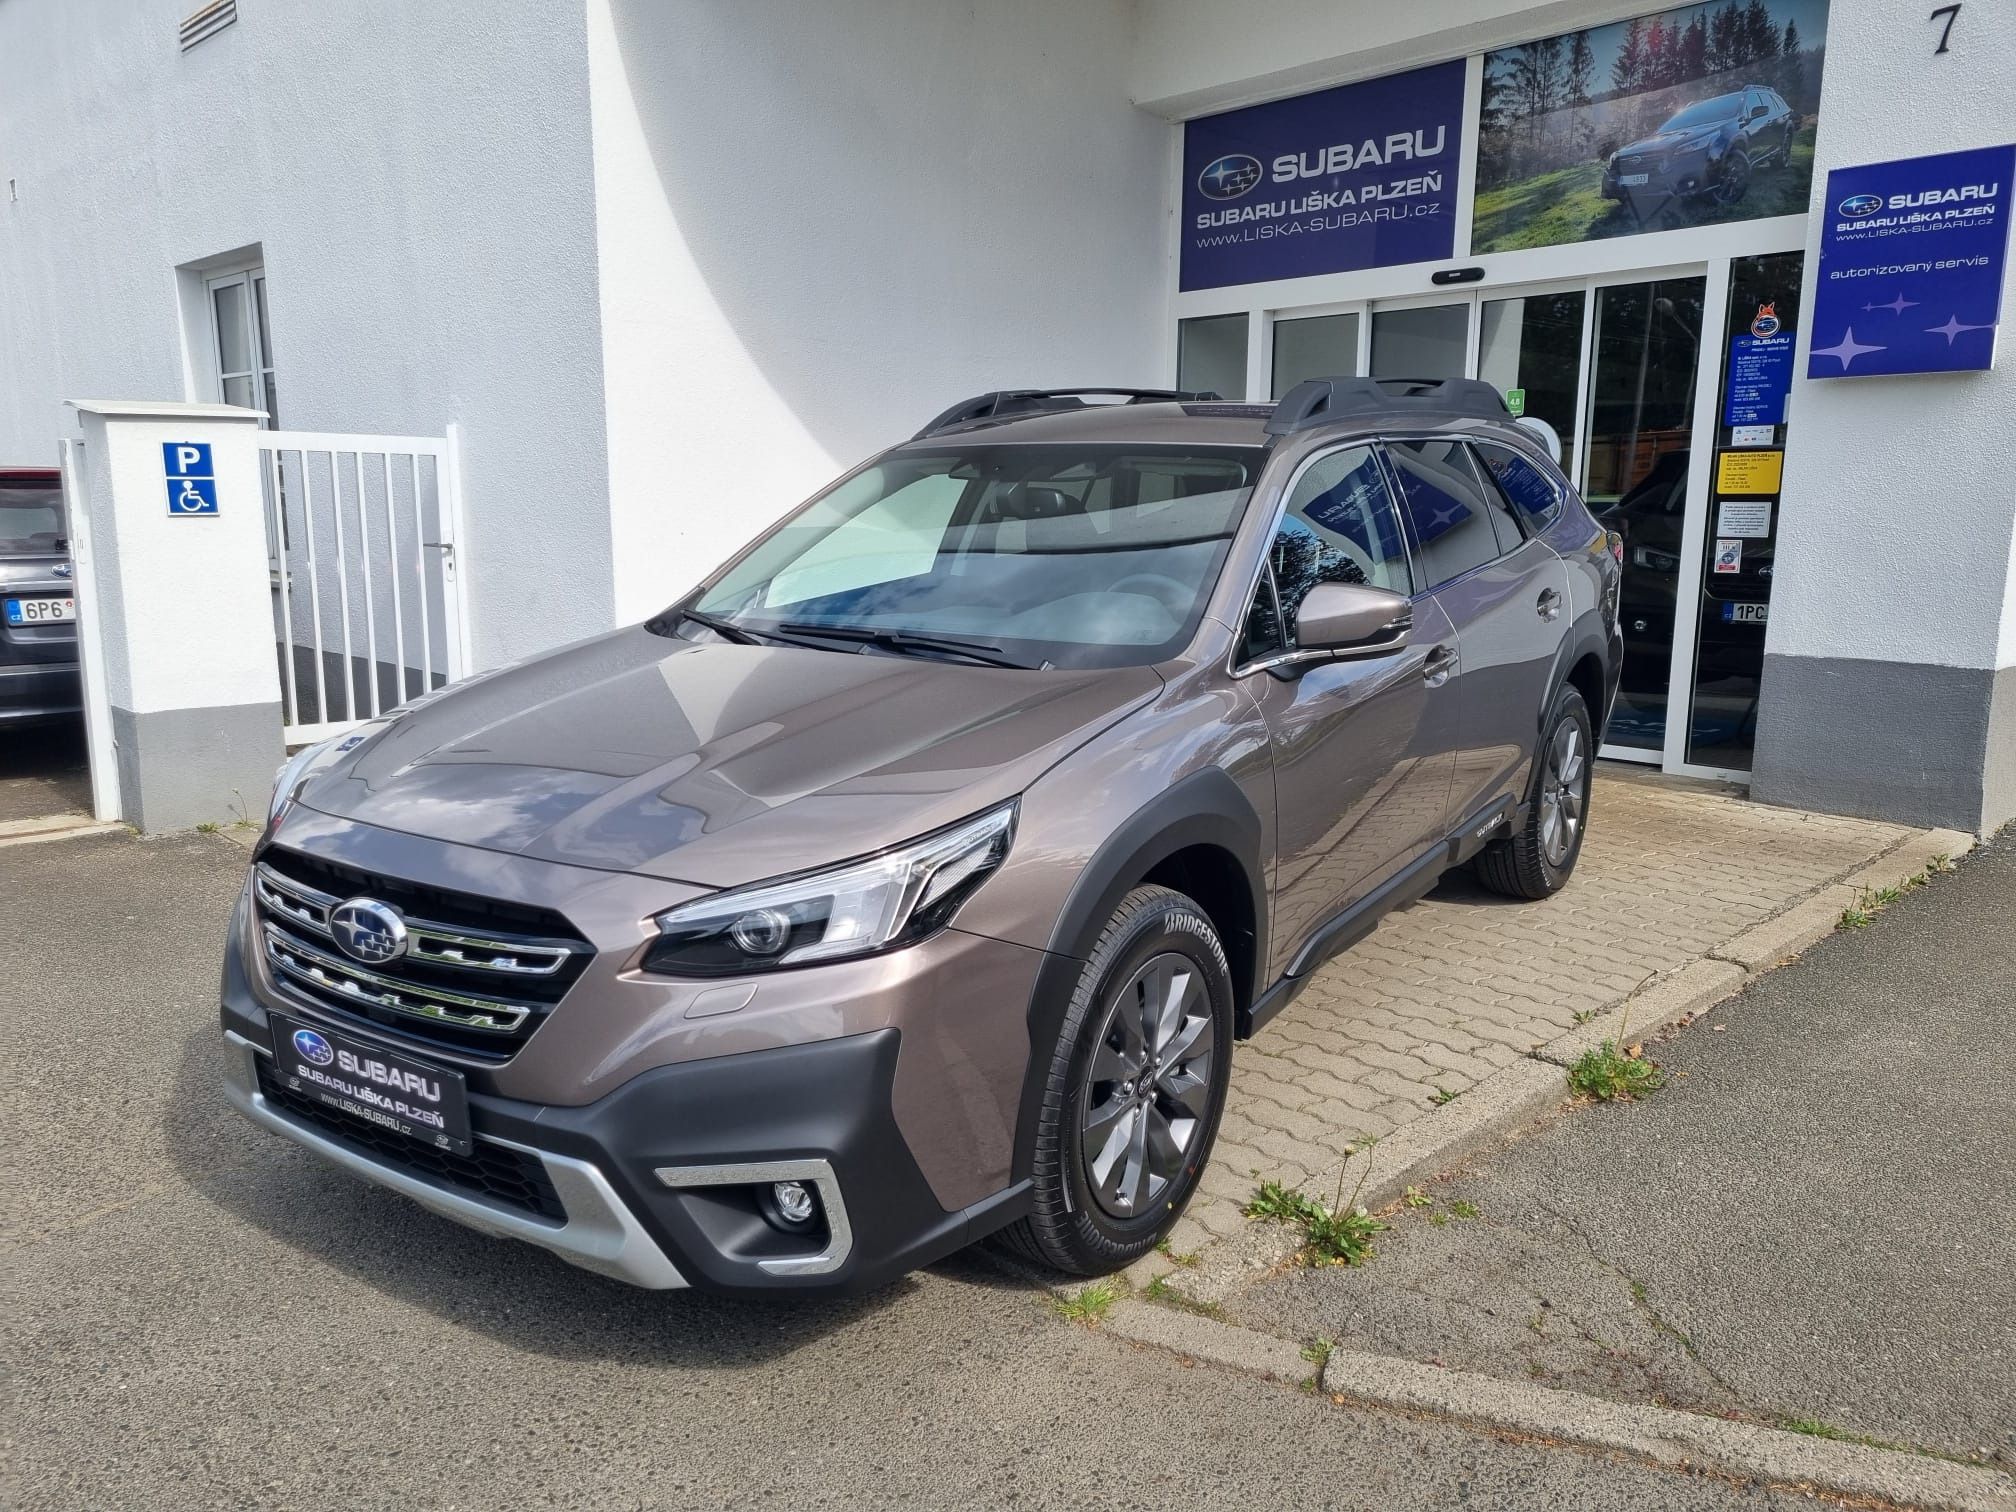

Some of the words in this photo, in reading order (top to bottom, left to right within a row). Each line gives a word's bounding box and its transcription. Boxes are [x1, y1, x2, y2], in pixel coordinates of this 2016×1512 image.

[1930, 3, 1962, 55] 7
[1271, 125, 1446, 183] SUBARU
[1197, 200, 1287, 230] SUBARU
[1290, 190, 1356, 216] LIŠKA
[1361, 169, 1443, 203] PLZEŇ
[1888, 182, 1999, 210] SUBARU
[1196, 202, 1441, 248] www.LISKA-SUBARU.cz
[1836, 216, 1898, 232] SUBARU
[1899, 211, 1943, 226] LIŠKA
[1945, 204, 1995, 220] PLZEŇ
[1836, 217, 1994, 241] www.LISKA-SUBARU.cz
[1830, 260, 1932, 280] autorizovaný
[1935, 254, 1989, 271] servis
[177, 446, 201, 474] P
[25, 601, 63, 620] 6P6
[1737, 605, 1765, 620] 1PC
[1164, 912, 1229, 977] BRIDGESTONE
[337, 1050, 441, 1102] SUBARU
[297, 1064, 353, 1095] SUBARU
[353, 1086, 394, 1111] LIŠKA
[395, 1100, 445, 1129] PLZEŇ
